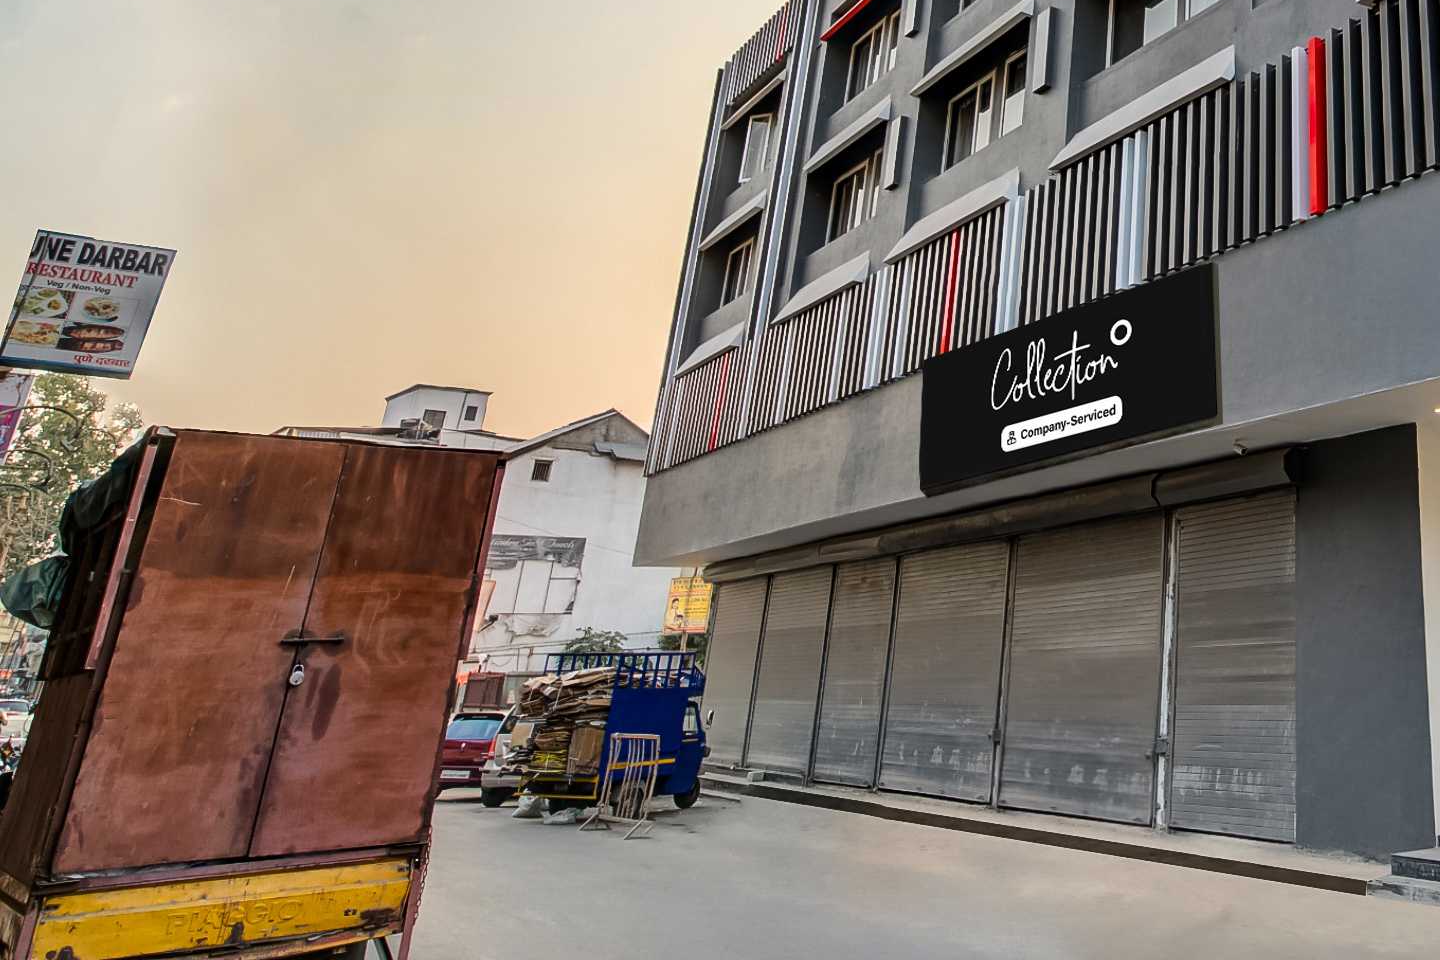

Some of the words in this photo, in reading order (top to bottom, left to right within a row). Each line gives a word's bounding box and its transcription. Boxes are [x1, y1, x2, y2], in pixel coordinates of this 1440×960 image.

[26, 261, 138, 288] RESTAURANT
[77, 242, 168, 276] DARBAR
[47, 280, 64, 289] Veg
[72, 282, 111, 295] Non-Veg
[991, 330, 1118, 410] Collection
[1020, 404, 1116, 440] Company-Serviced
